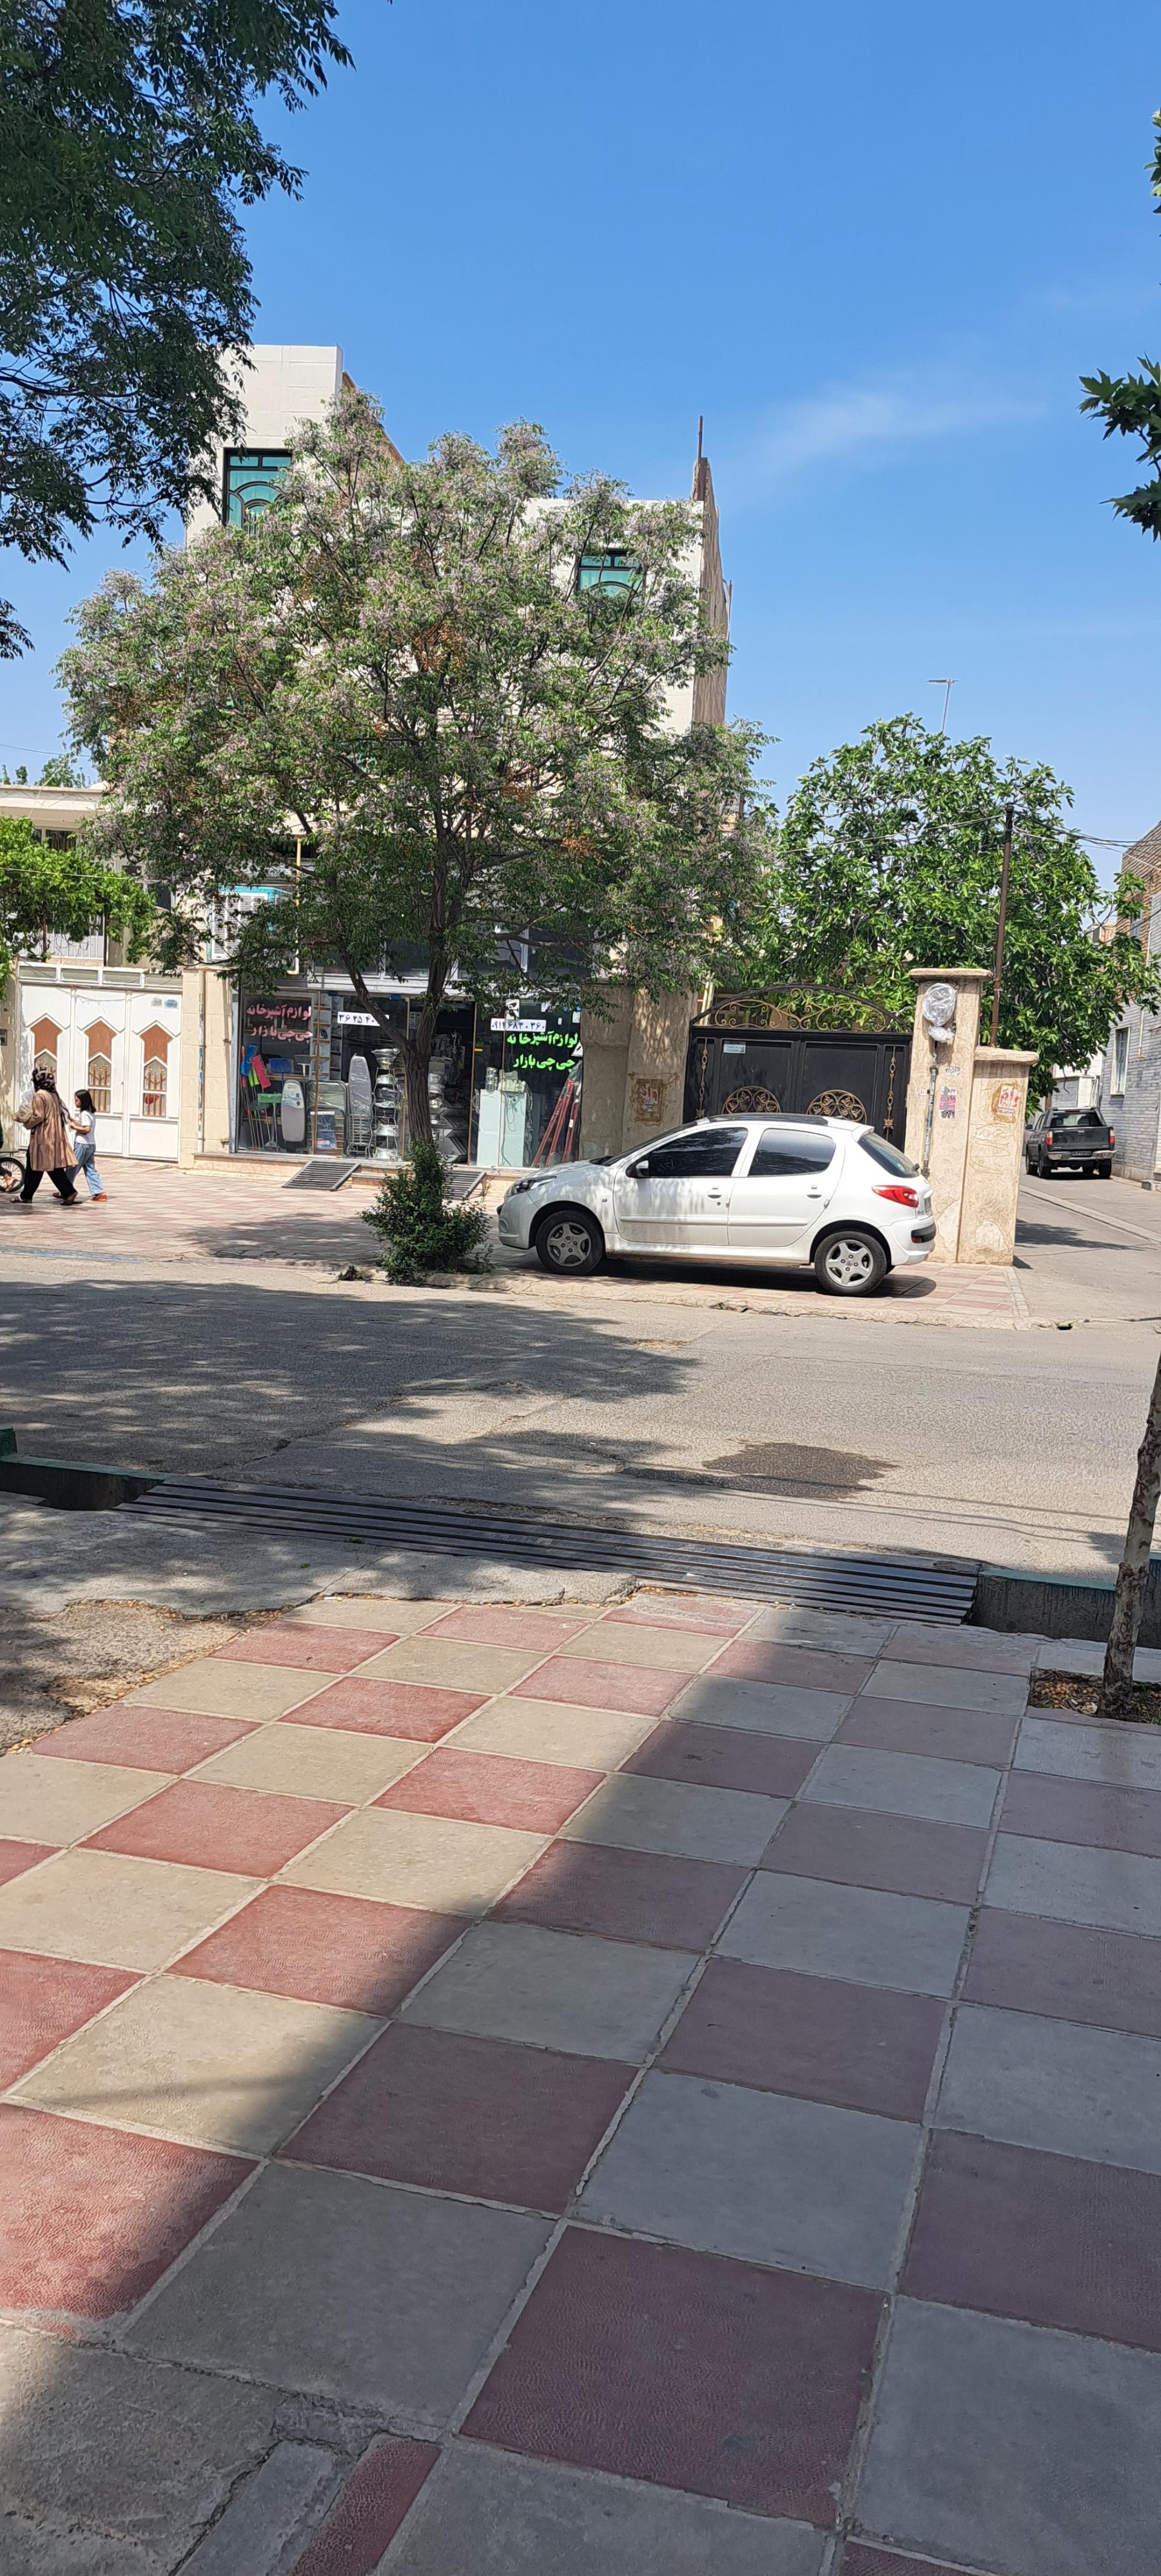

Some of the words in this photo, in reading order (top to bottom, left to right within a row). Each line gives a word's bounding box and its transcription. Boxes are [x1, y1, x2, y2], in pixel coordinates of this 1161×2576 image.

[246, 1003, 287, 1020] آشپزخانه
[287, 1006, 312, 1021] لوازم
[339, 1014, 351, 1023] ۳۶
[250, 1025, 277, 1040] بازار
[552, 1032, 579, 1049] لوازم
[513, 1053, 536, 1069] بازار
